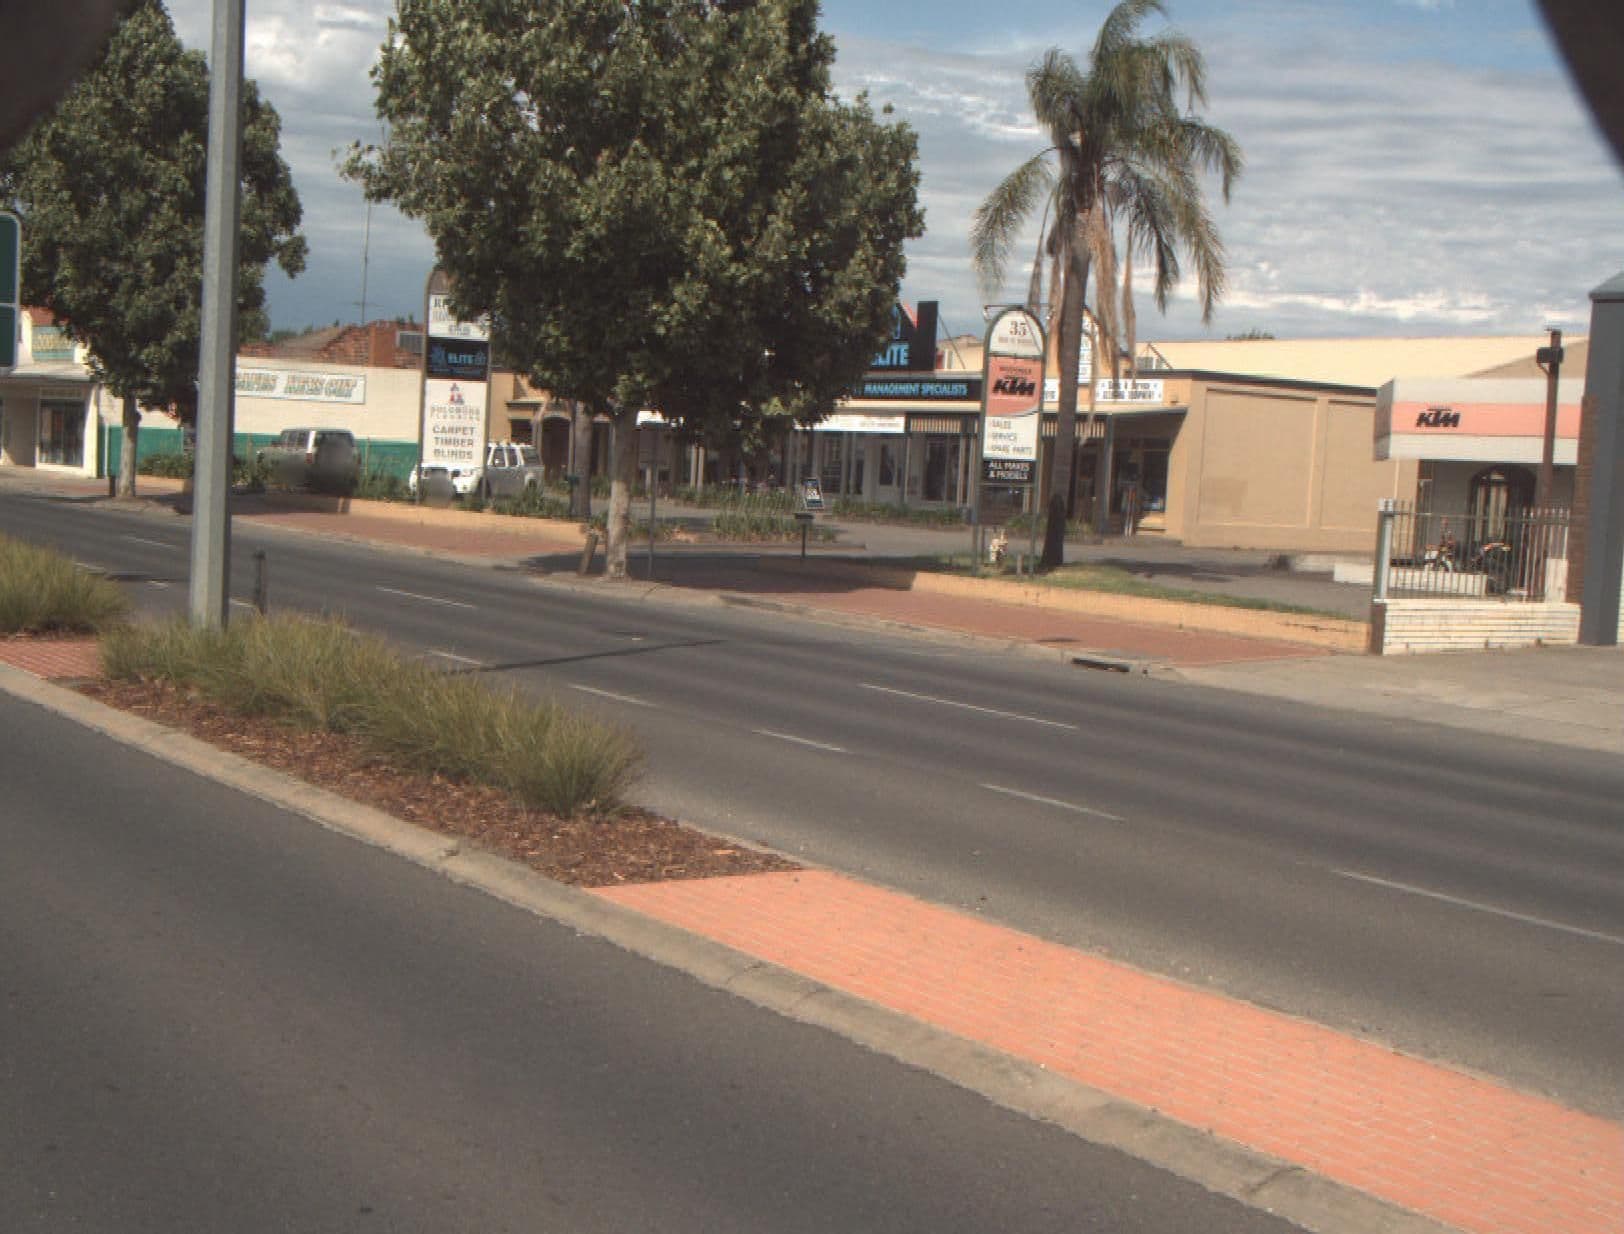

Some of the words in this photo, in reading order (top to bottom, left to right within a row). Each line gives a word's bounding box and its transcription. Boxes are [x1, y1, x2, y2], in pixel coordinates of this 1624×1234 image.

[871, 342, 910, 366] LITE
[863, 383, 919, 397] MANAGEMENT
[921, 383, 968, 397] SPECIALISTS
[992, 378, 1036, 397] KTM
[1416, 407, 1460, 428] KTM
[992, 419, 1011, 429] SALES
[432, 425, 475, 436] CARPET
[434, 437, 474, 448] TIMBER
[992, 433, 1017, 442] SERVICE
[434, 448, 473, 460] BLINDS
